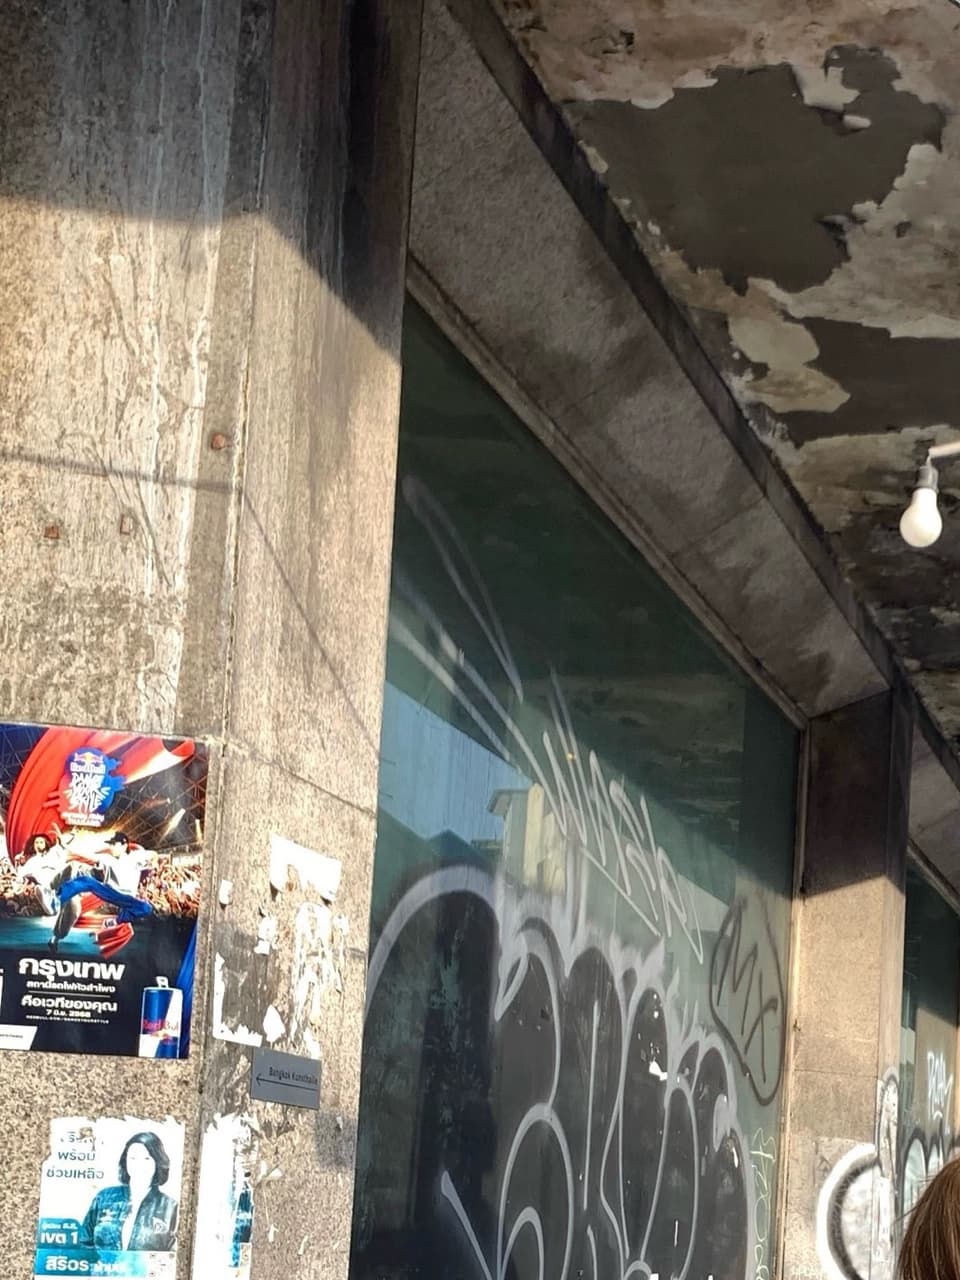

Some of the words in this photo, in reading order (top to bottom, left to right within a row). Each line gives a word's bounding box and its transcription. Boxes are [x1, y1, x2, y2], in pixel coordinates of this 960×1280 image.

[18, 957, 126, 982] กรุงเทพ
[21, 994, 118, 1014] คือเวทีของคุณ
[71, 1231, 79, 1245] 1
